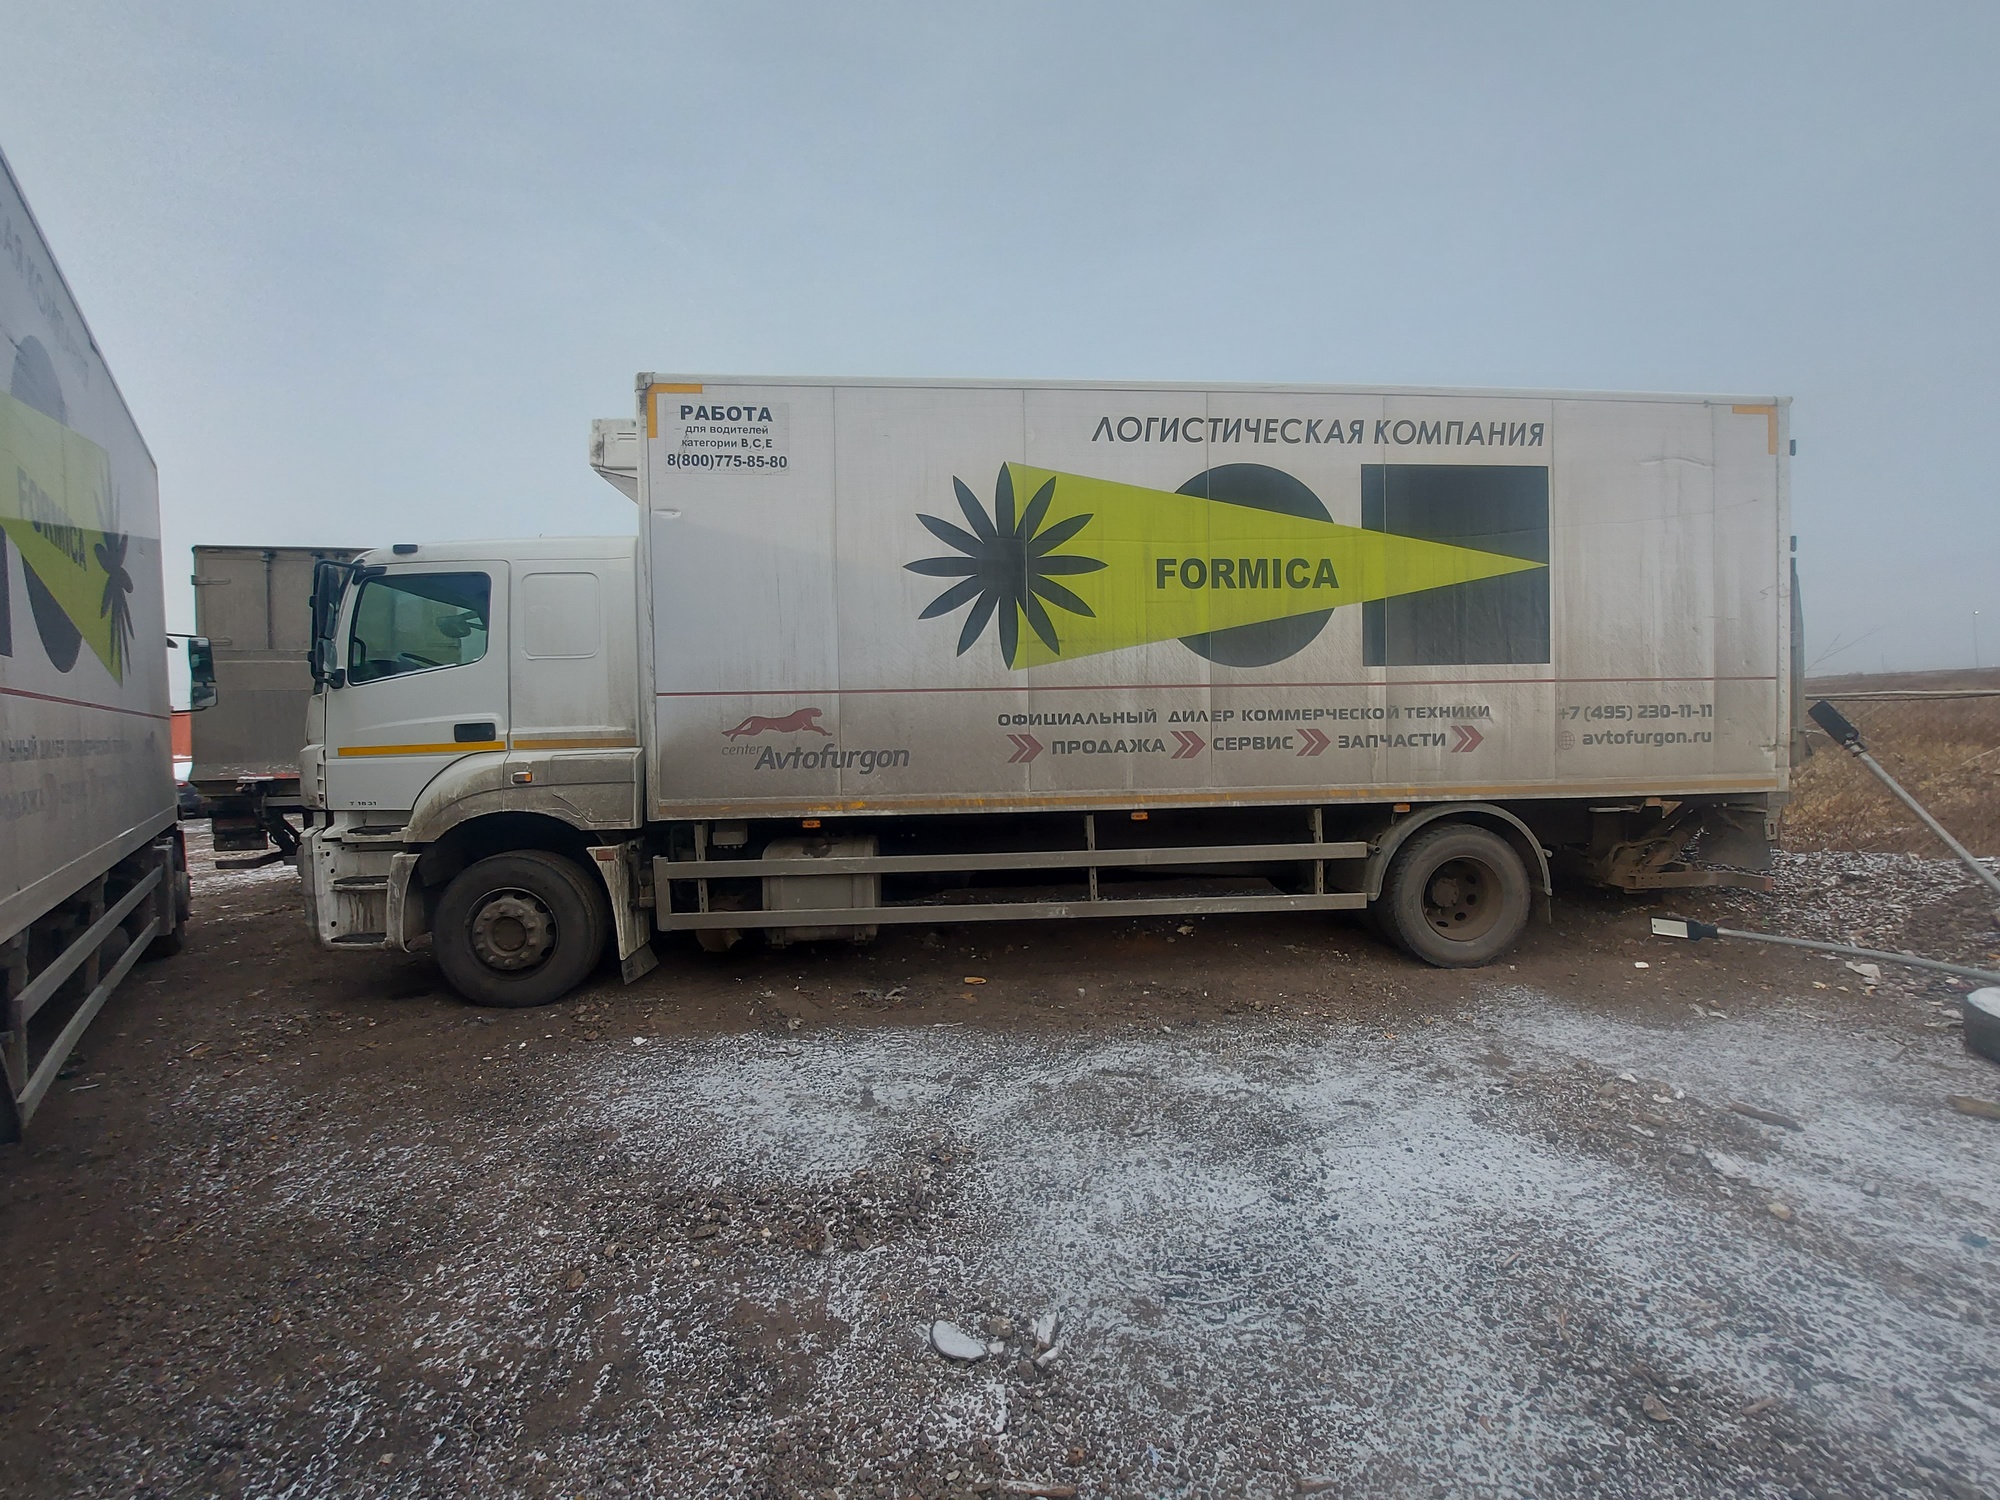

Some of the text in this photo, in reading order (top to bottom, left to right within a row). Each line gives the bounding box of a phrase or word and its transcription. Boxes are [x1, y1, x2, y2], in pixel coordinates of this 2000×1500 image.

[680, 405, 773, 422] РАБОТА
[685, 425, 769, 435] для водителей
[1092, 416, 1544, 447] ЛОГИСТИЧЕСКАЯ КОМПАНИЯ
[681, 438, 738, 449] категории
[667, 453, 788, 470] 8(800)775-85-80
[1156, 557, 1340, 590] FORMICA
[998, 704, 1490, 726] ОФИЦИАЛЬНЫЙ ДИЛЕР КОММЕРЧЕСКОЙ ТЕХНИКИ
[1584, 705, 1633, 722] (495)
[1637, 704, 1712, 719] 230-11-11
[1052, 733, 1446, 754] ПРОДАЖА СЕРВИС ЗАПЧАСТИ
[1582, 730, 1712, 747] avtofurgon.ru
[721, 743, 910, 775] center Avtofurgon
